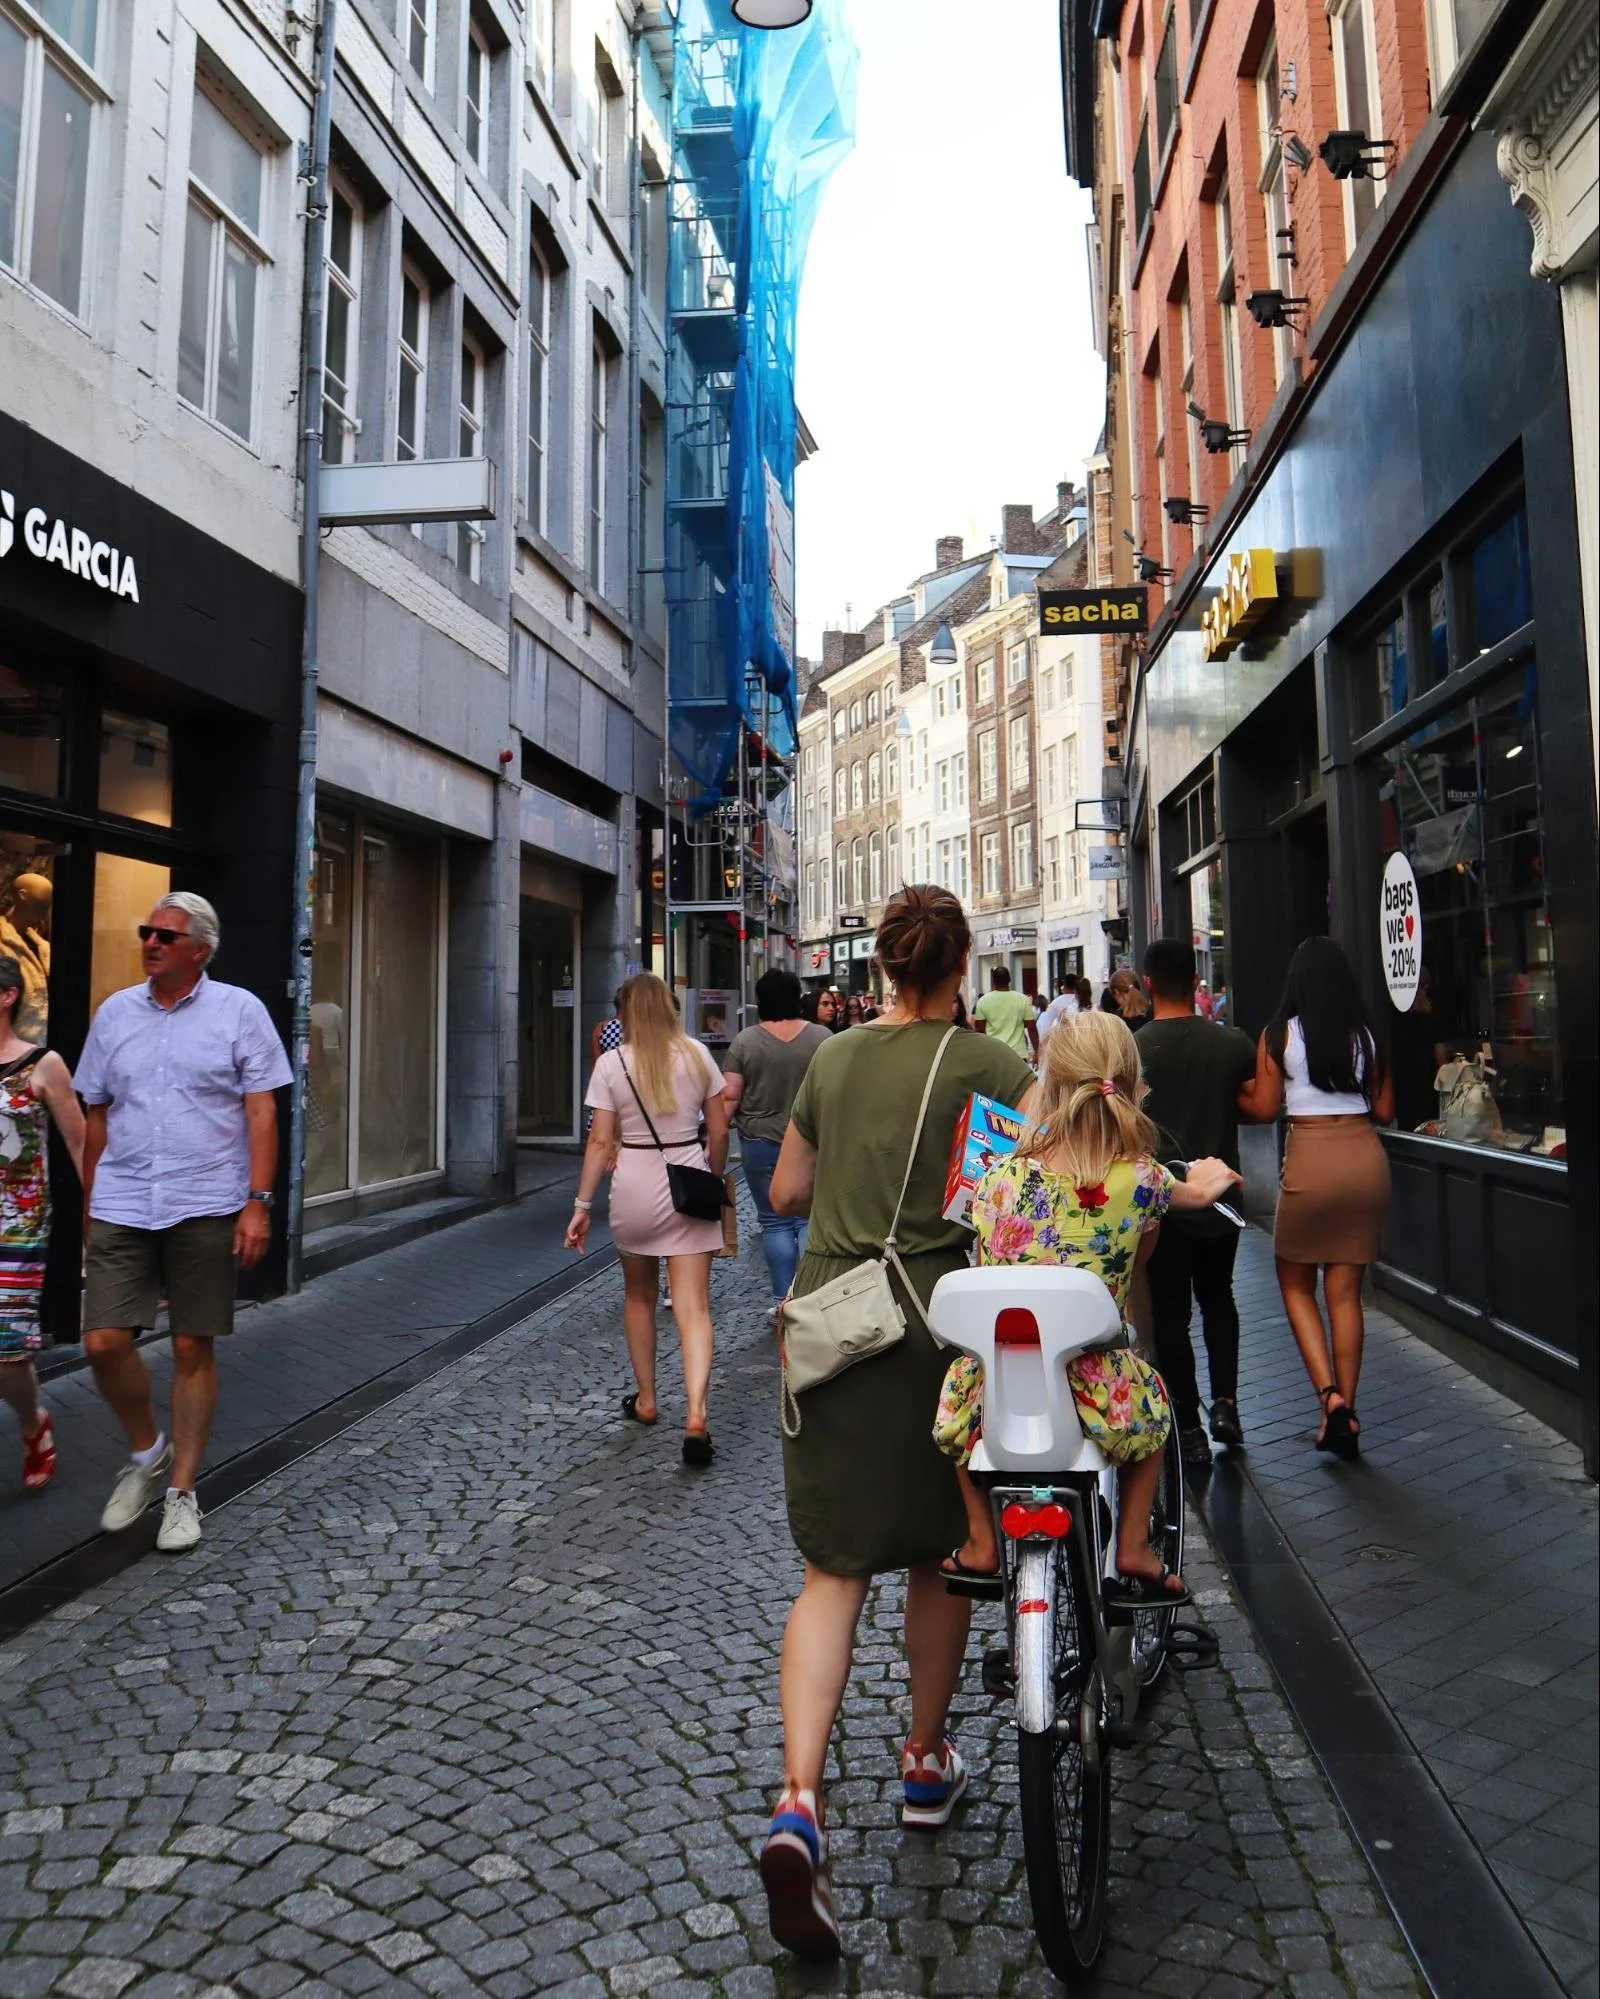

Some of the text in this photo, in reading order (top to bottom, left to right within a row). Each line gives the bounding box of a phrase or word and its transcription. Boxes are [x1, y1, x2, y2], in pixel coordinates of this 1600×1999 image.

[23, 507, 140, 603] GARCIA
[1044, 599, 1139, 623] sacha
[1384, 878, 1413, 916] bags
[1386, 917, 1404, 944] we
[1388, 947, 1416, 978] -20%
[987, 1111, 1020, 1140] TW
